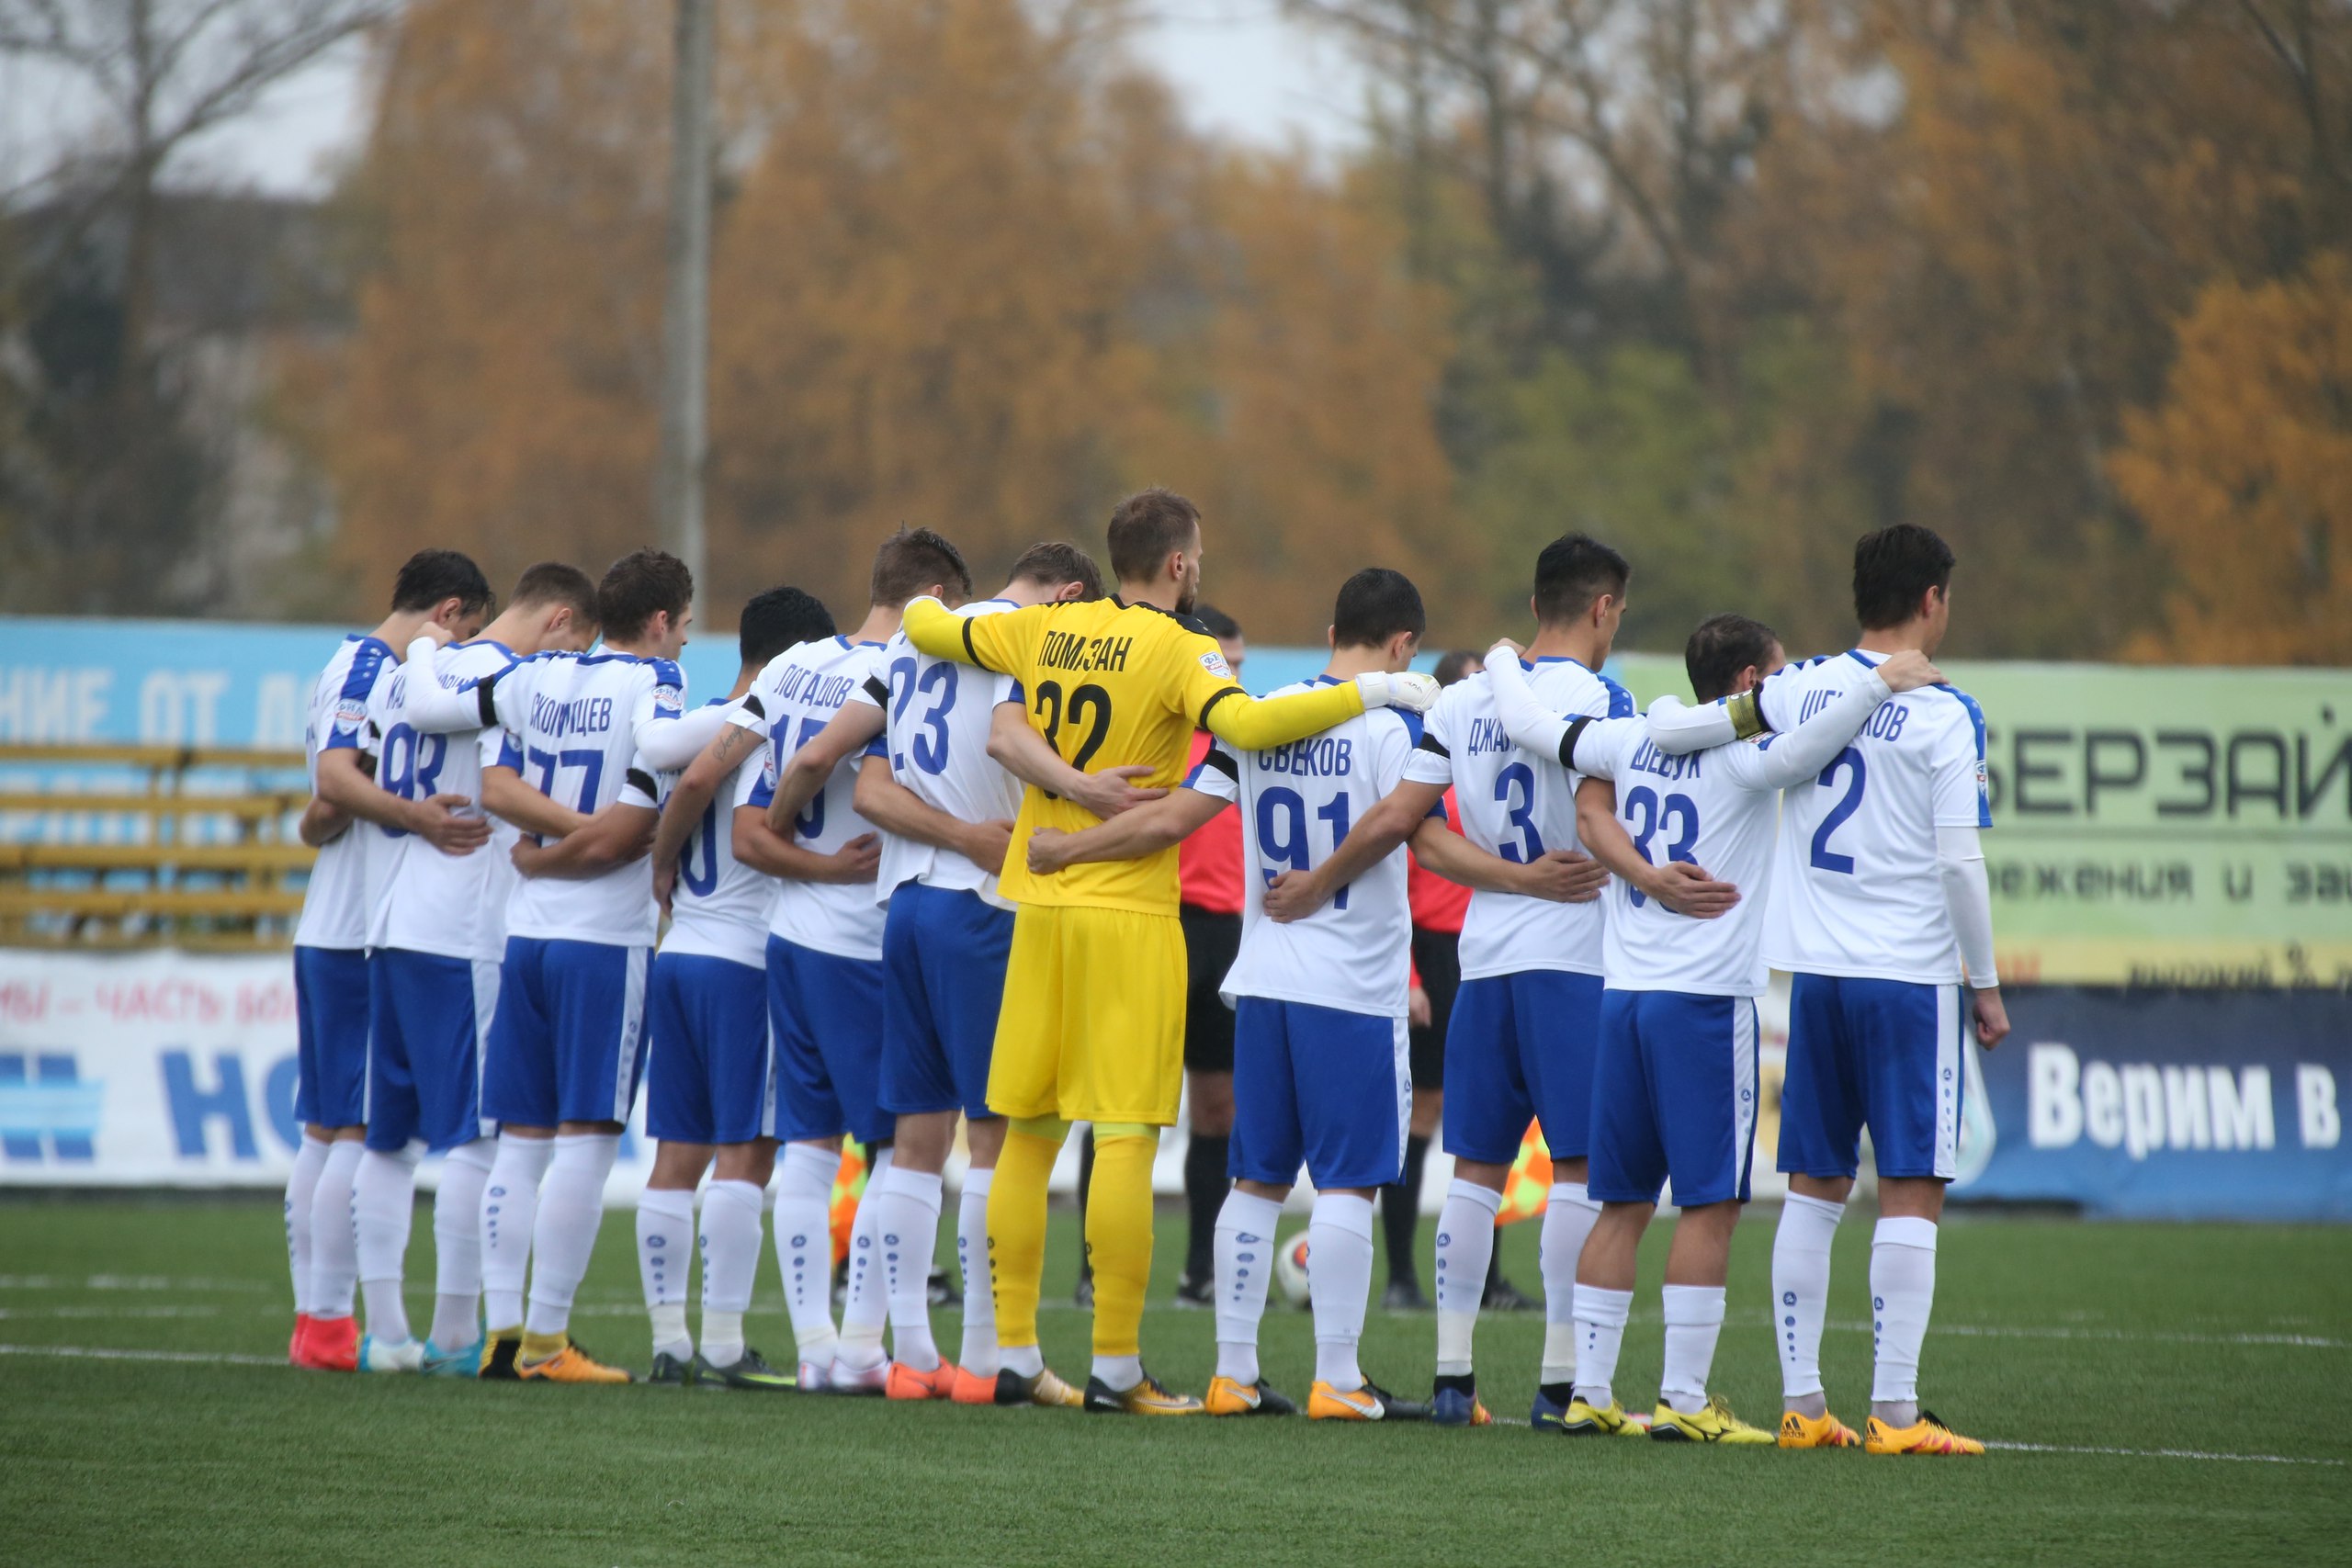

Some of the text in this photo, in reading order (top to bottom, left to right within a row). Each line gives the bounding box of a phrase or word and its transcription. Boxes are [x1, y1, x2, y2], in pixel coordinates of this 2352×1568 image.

[888, 656, 958, 776] 23
[527, 745, 605, 847] 77
[1256, 786, 1350, 910] 91
[1494, 761, 1545, 864] 3
[1624, 785, 1700, 913] 33
[1810, 746, 1866, 874] 2
[2028, 1043, 2276, 1161] Верим
